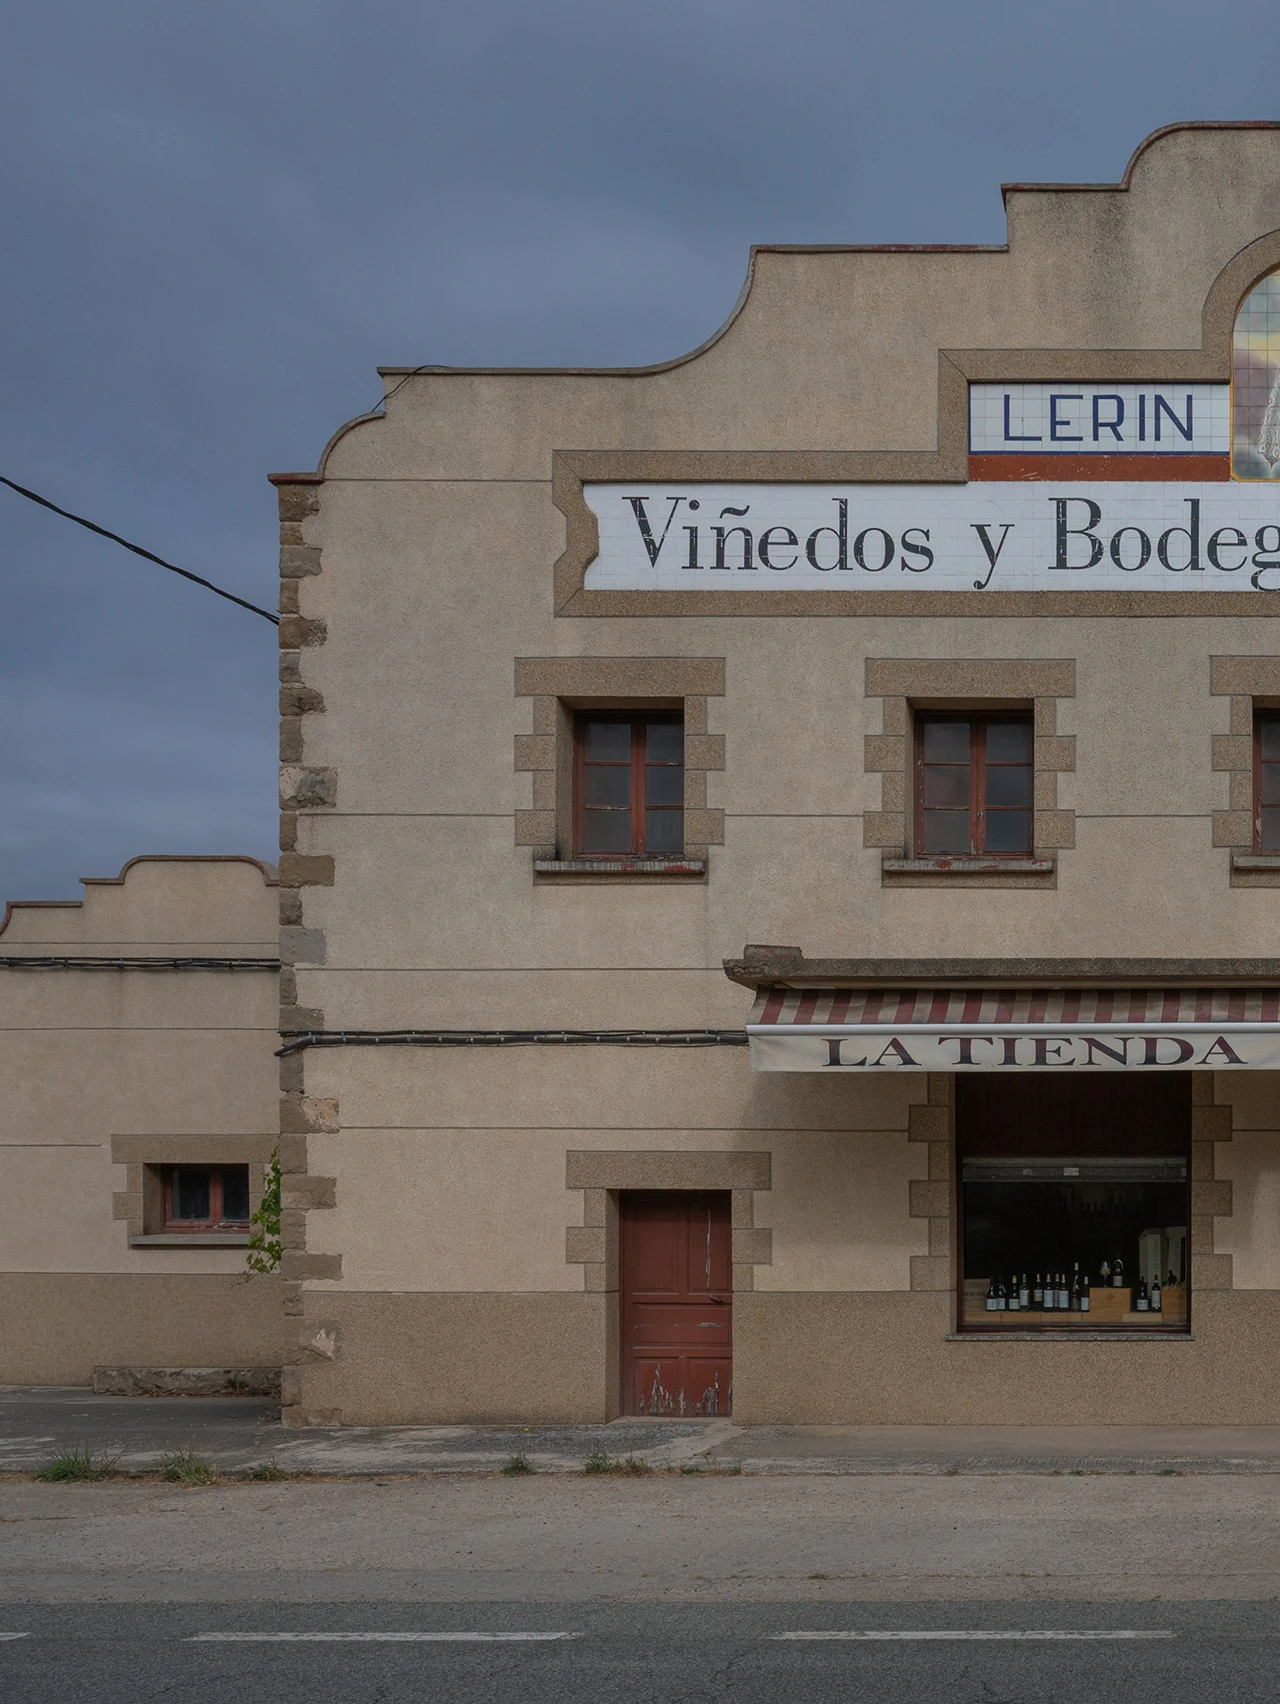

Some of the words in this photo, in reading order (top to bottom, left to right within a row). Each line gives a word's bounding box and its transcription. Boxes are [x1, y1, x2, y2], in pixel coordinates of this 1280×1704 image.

[1003, 394, 1194, 442] LERIN
[621, 496, 935, 573] Viñedos
[969, 523, 1015, 590] y
[821, 1036, 923, 1067] LA
[937, 1035, 1249, 1067] TIENDA
